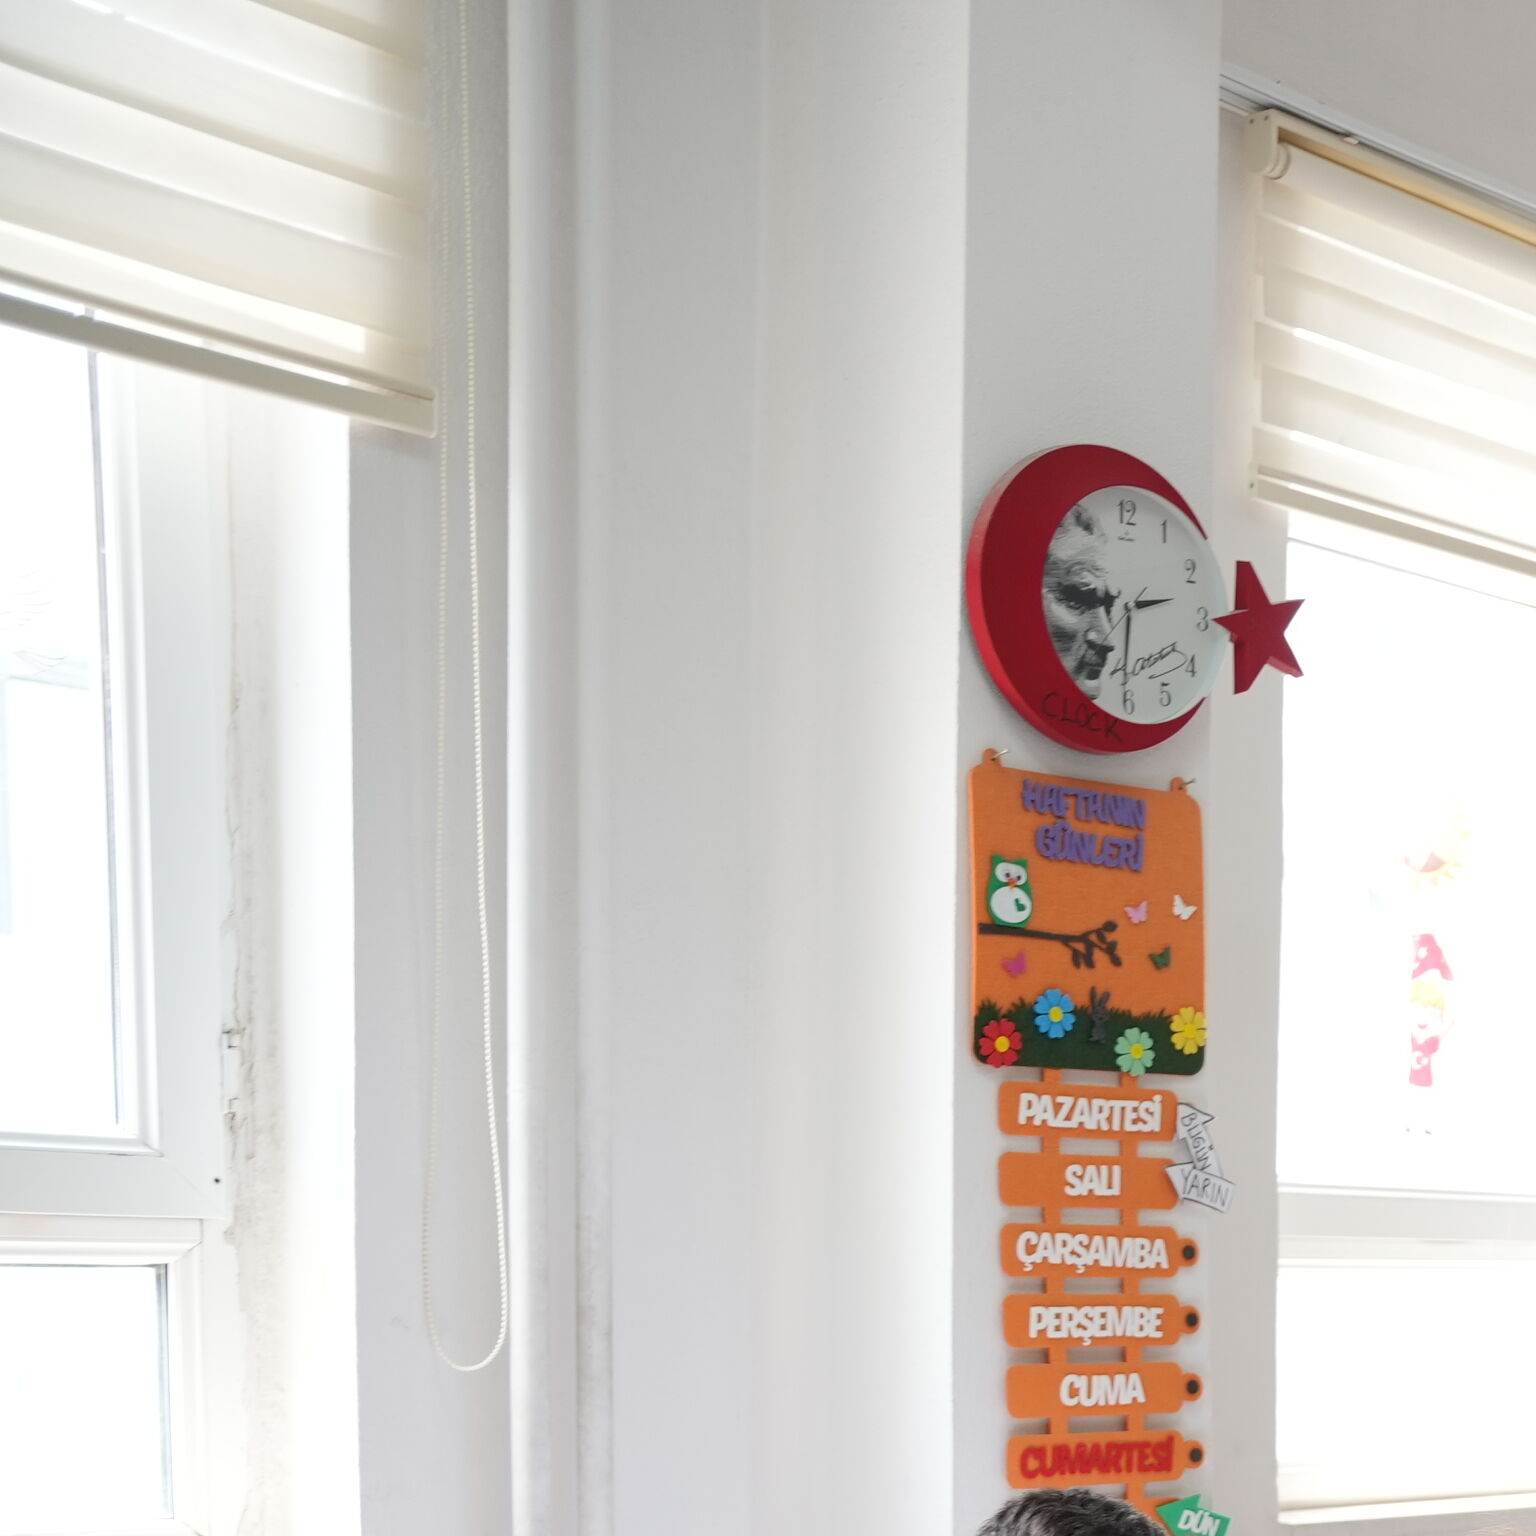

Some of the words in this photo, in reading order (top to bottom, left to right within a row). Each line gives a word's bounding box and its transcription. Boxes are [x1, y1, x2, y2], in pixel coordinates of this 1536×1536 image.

[1117, 499, 1137, 526] 12
[1161, 520, 1168, 544] 1
[1184, 559, 1197, 584] 2
[1196, 606, 1210, 632] 3
[1185, 654, 1197, 678] 4
[1122, 689, 1135, 715] 6
[1160, 682, 1172, 707] 5
[1042, 692, 1124, 743] CLOCK
[1021, 778, 1147, 830] HAFTANIN
[1035, 820, 1144, 872] GÜNLERİ
[1018, 1092, 1163, 1133] PAZARTESİ
[1180, 1112, 1215, 1172] BUGÜN
[1064, 1163, 1122, 1197] SALI
[1181, 1168, 1230, 1207] YARIN
[1016, 1231, 1169, 1273] ÇARŞAMBA
[1028, 1305, 1165, 1346] PERŞEMBE
[1059, 1372, 1146, 1407] CUMA
[1020, 1435, 1175, 1480] CUMARTESİ
